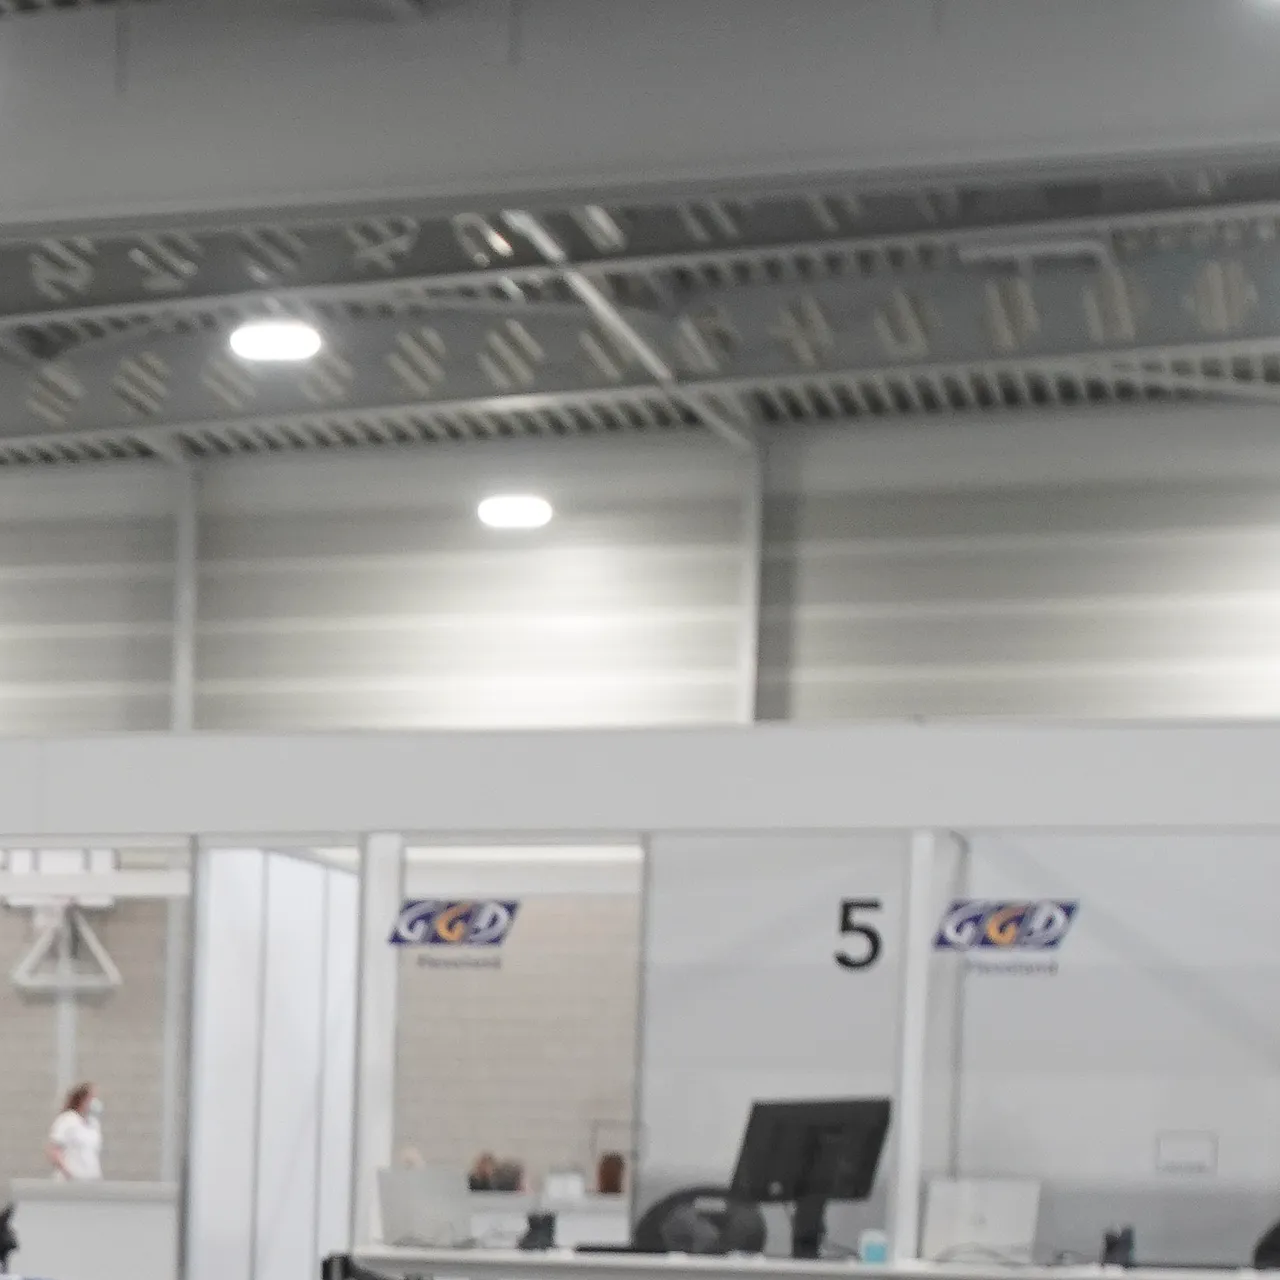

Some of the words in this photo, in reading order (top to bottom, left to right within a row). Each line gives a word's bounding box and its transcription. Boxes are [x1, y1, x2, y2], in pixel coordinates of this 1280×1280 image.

[391, 899, 518, 944] GGD
[835, 899, 882, 970] 5
[936, 900, 1078, 948] GGD
